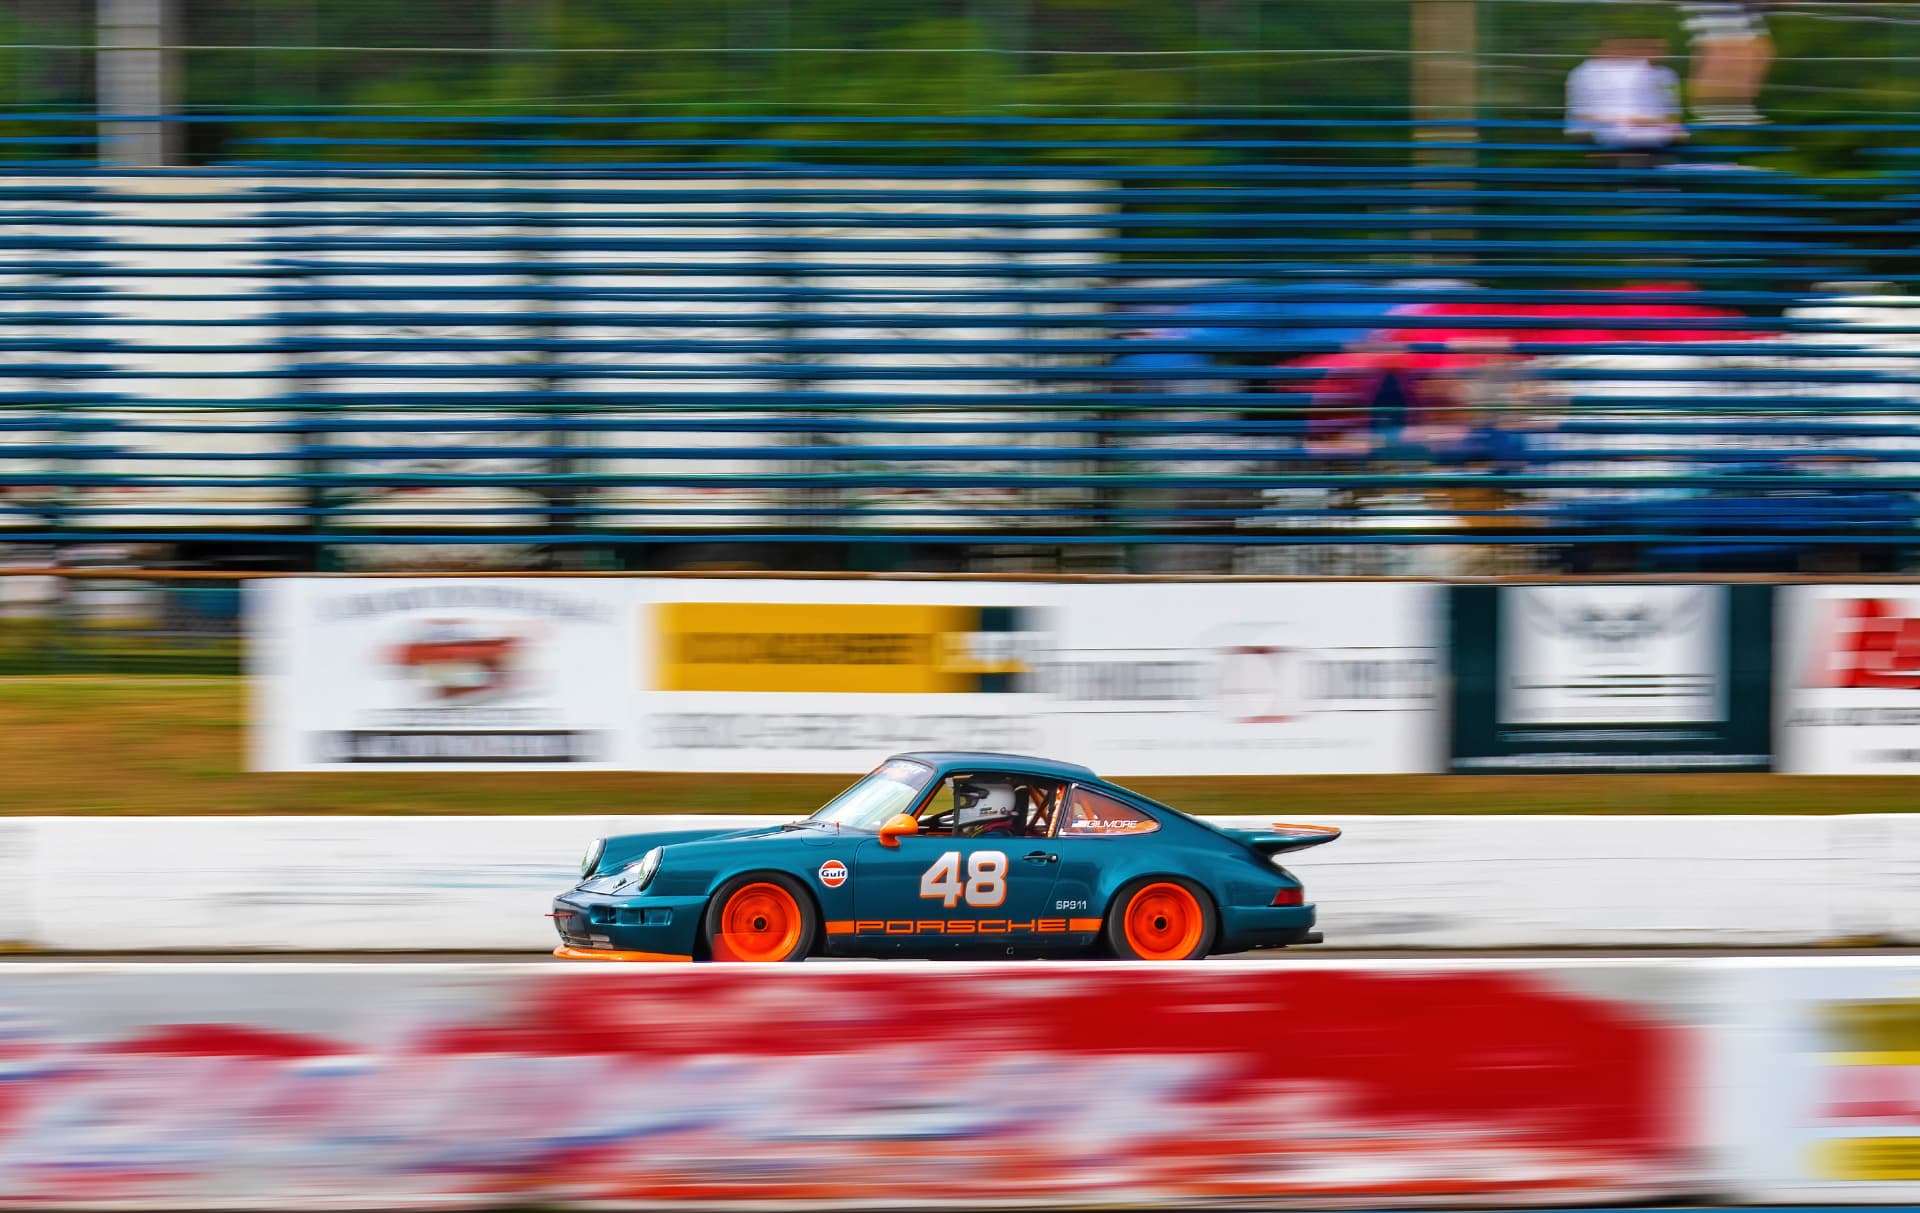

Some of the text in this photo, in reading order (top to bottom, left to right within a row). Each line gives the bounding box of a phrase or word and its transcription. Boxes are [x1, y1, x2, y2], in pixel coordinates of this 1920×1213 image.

[1087, 820, 1138, 828] GILMORE
[821, 869, 846, 878] Gulf
[919, 850, 1009, 908] 48
[855, 919, 1066, 934] PORSCHE
